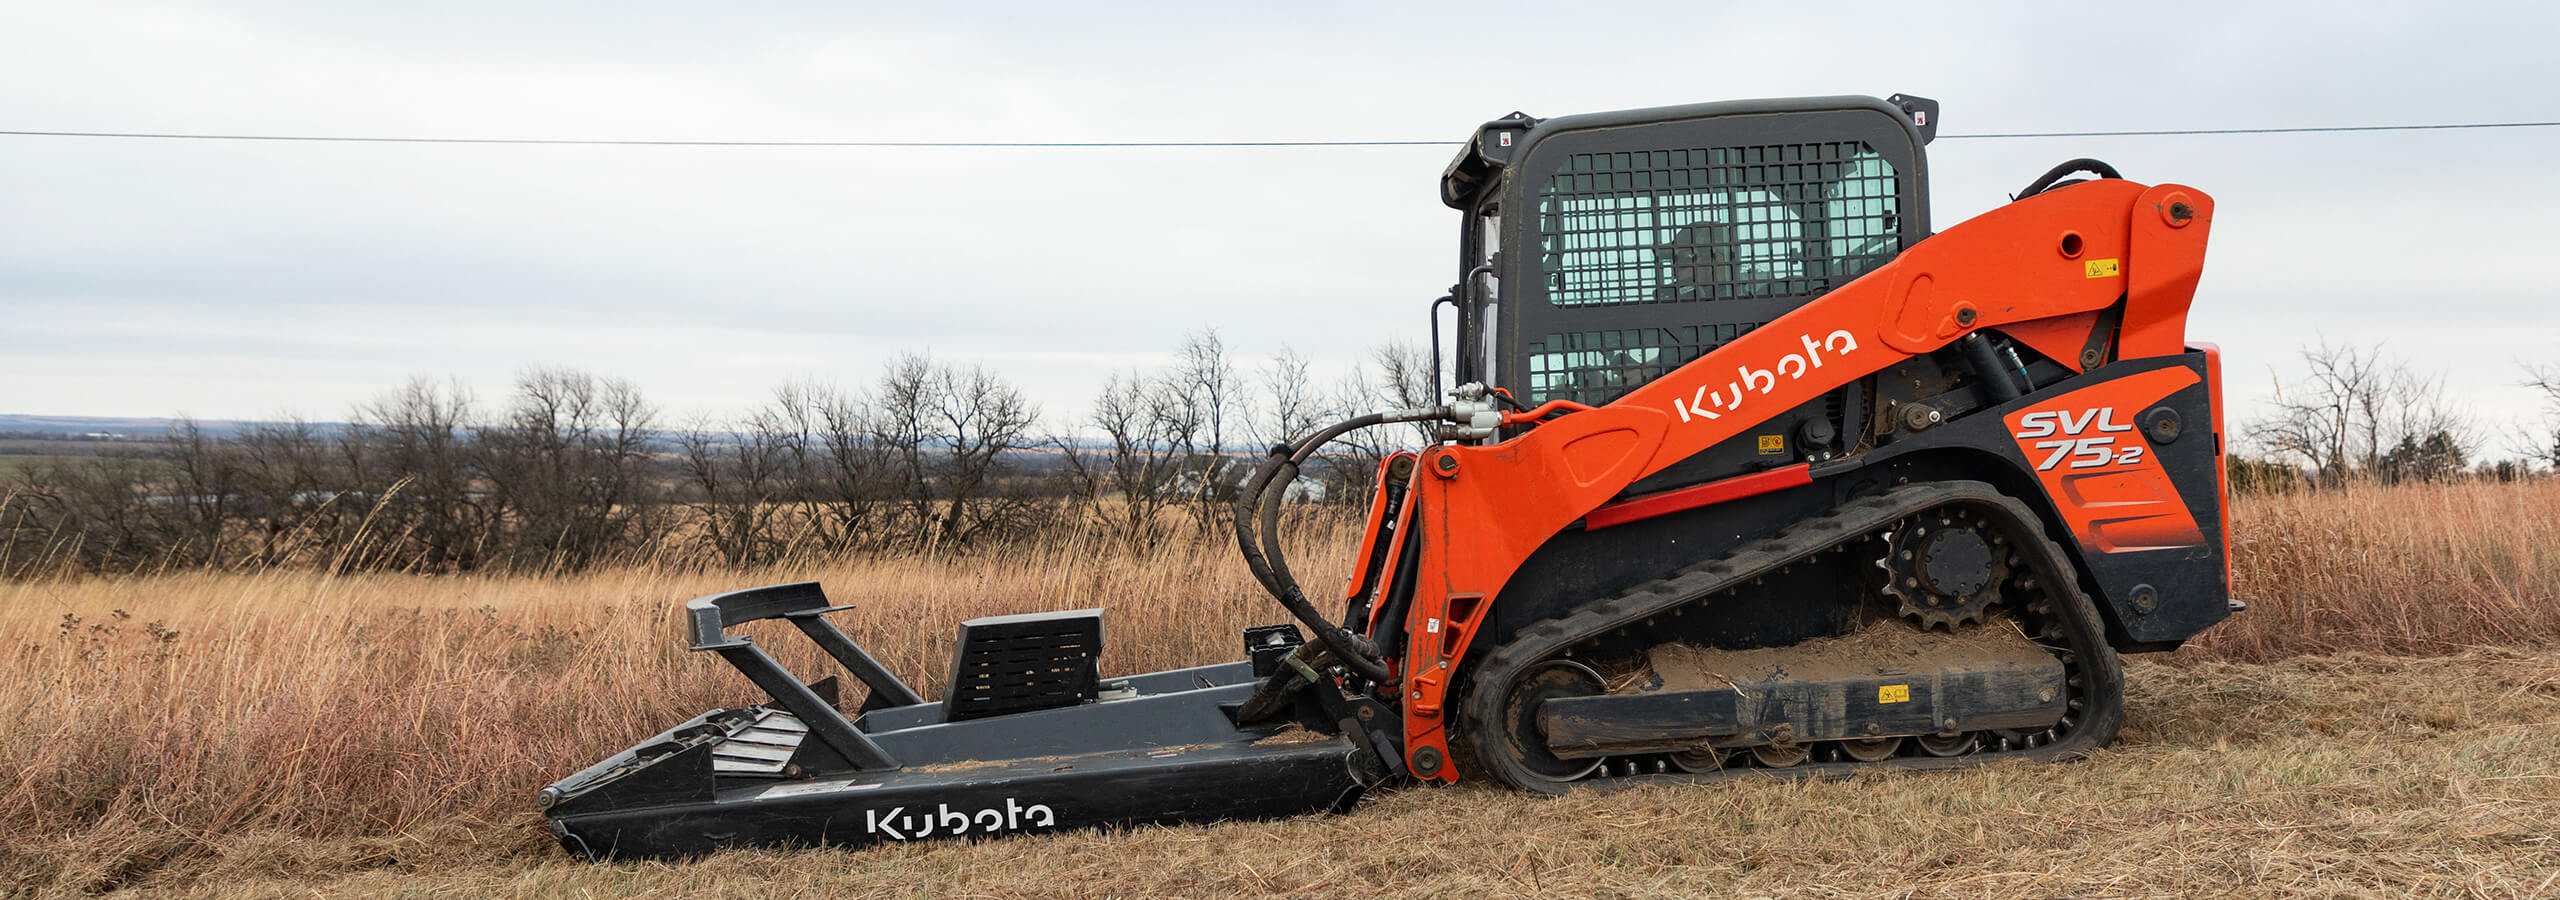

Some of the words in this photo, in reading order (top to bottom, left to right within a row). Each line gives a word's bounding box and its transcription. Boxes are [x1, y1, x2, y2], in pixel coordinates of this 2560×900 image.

[1674, 330, 1858, 422] Kubota
[2016, 407, 2132, 438] SVL
[2035, 437, 2144, 471] 75-2
[866, 798, 1055, 842] Kubota
